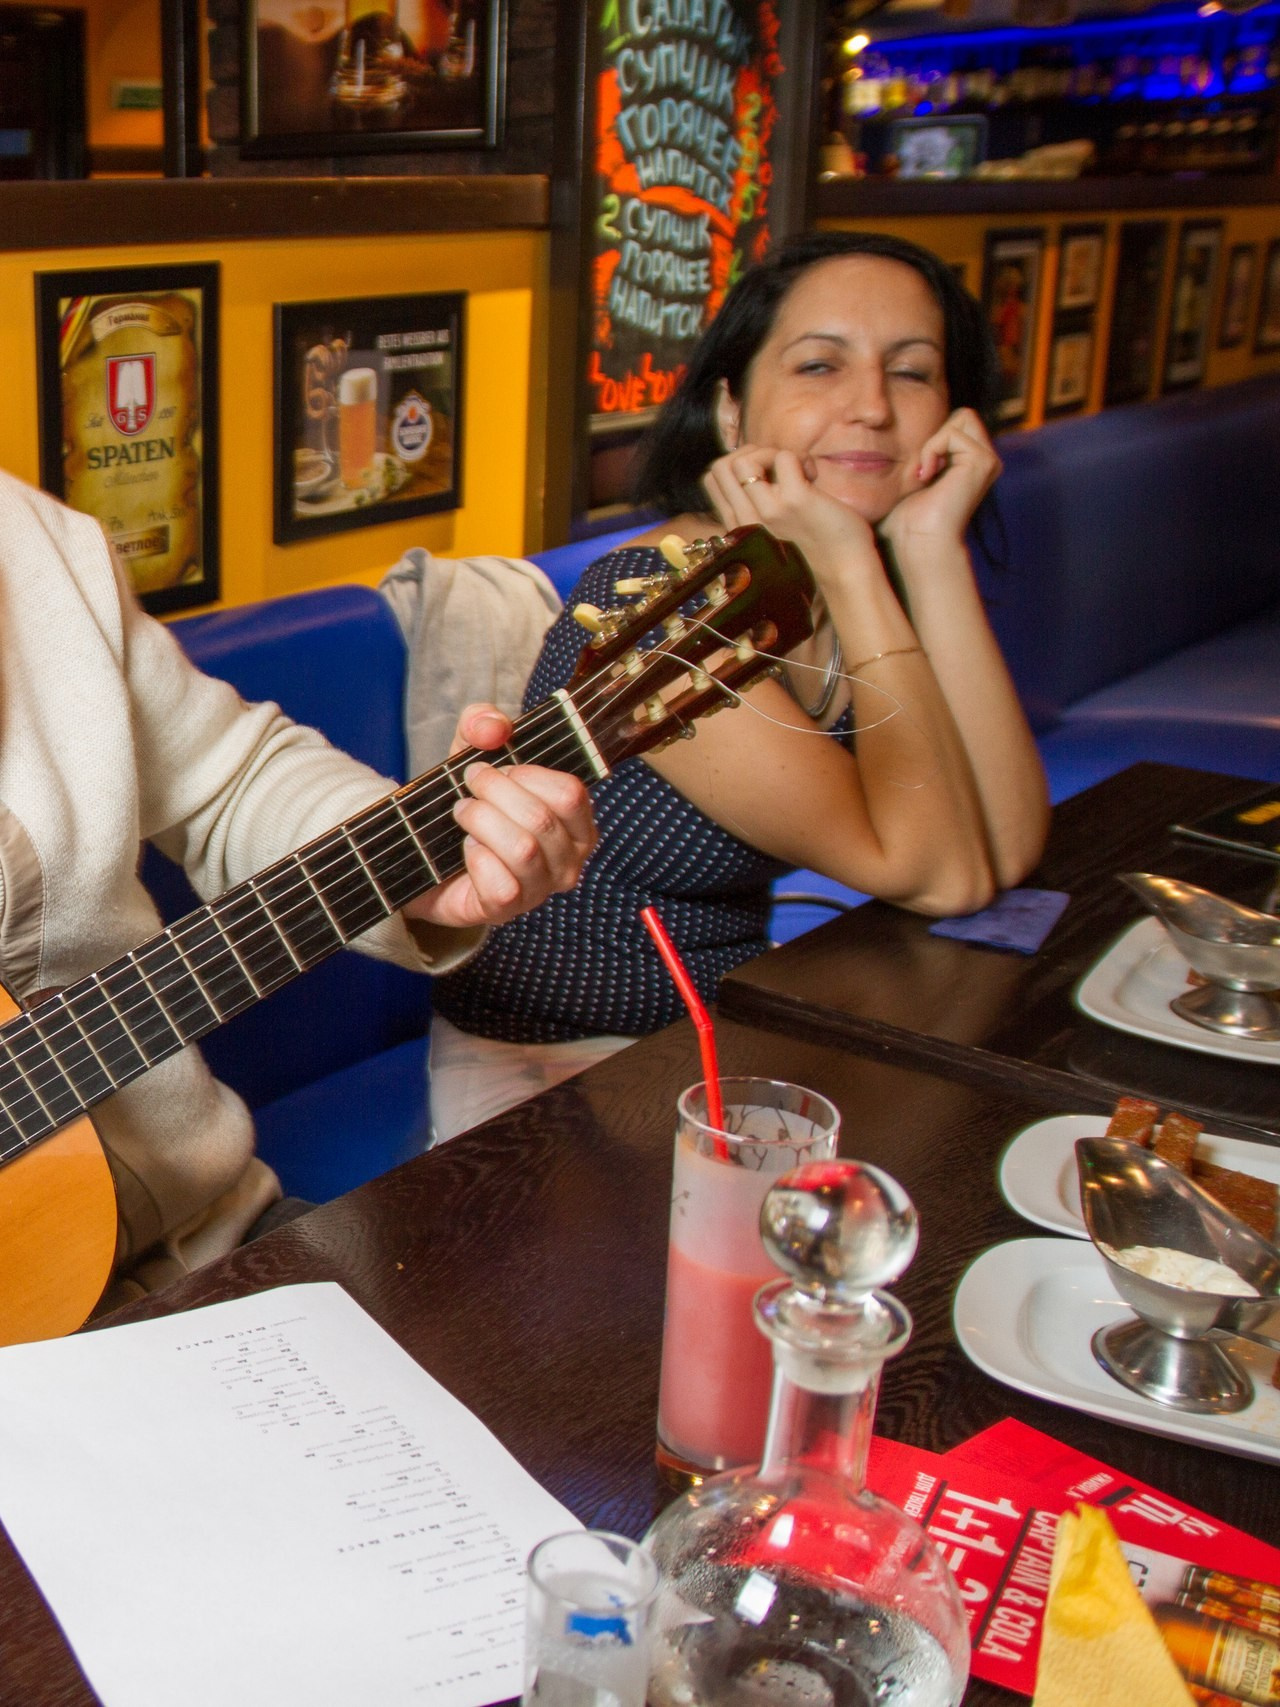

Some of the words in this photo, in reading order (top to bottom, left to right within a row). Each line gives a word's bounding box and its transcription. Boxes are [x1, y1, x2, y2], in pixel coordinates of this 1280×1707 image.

[87, 437, 176, 470] SPATEN
[111, 534, 161, 554] ветлое
[1001, 1588, 1044, 1609] &
[979, 1606, 1036, 1662] COLA
